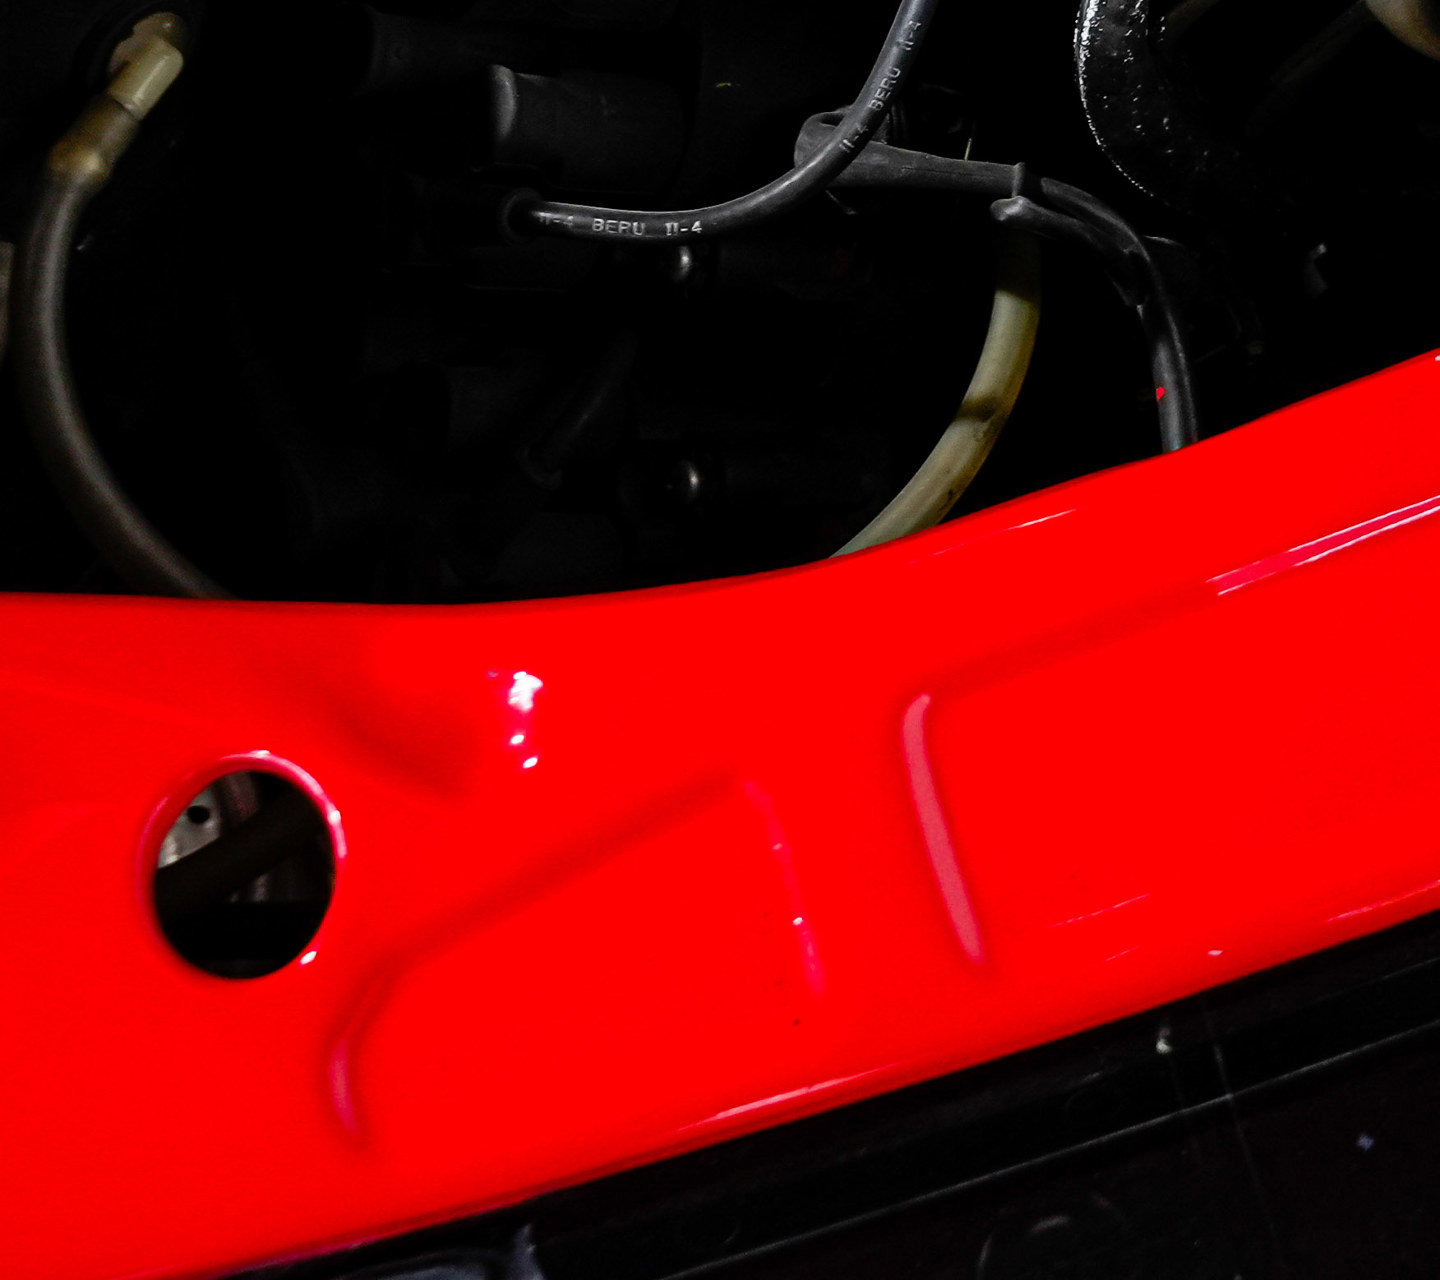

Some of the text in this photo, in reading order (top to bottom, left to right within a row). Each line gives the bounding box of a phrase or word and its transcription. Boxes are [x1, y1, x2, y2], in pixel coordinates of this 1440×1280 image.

[867, 67, 902, 112] BERU
[591, 217, 647, 236] BERU
[664, 220, 703, 237] II-4
